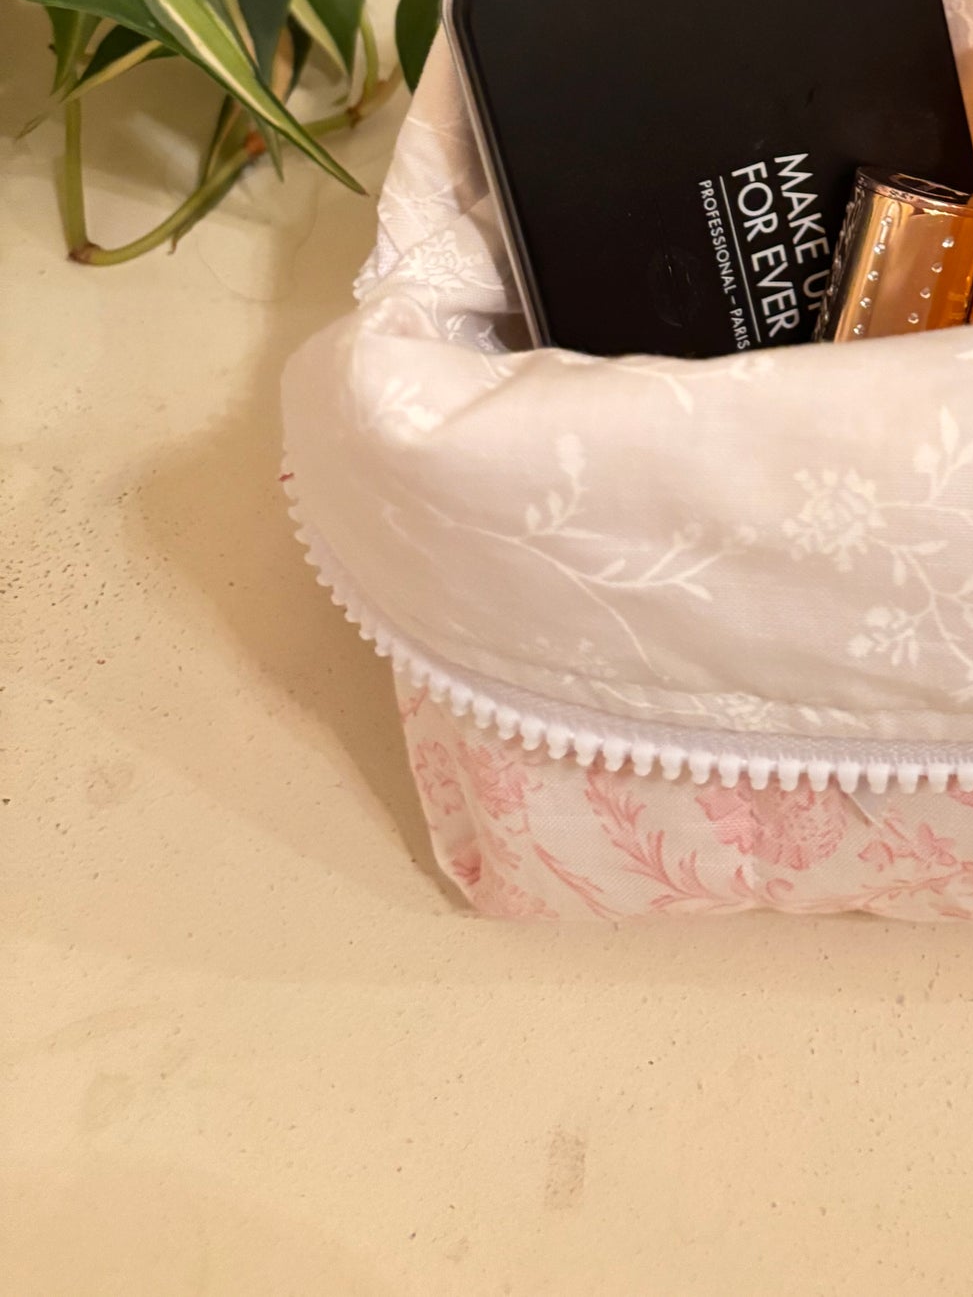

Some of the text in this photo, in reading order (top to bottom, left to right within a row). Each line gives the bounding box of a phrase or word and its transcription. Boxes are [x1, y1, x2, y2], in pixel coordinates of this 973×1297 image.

[698, 179, 737, 293] PROFESSIONAL
[729, 308, 750, 350] PARIS
[731, 161, 800, 338] FOR EVER
[774, 153, 830, 264] MAKE
